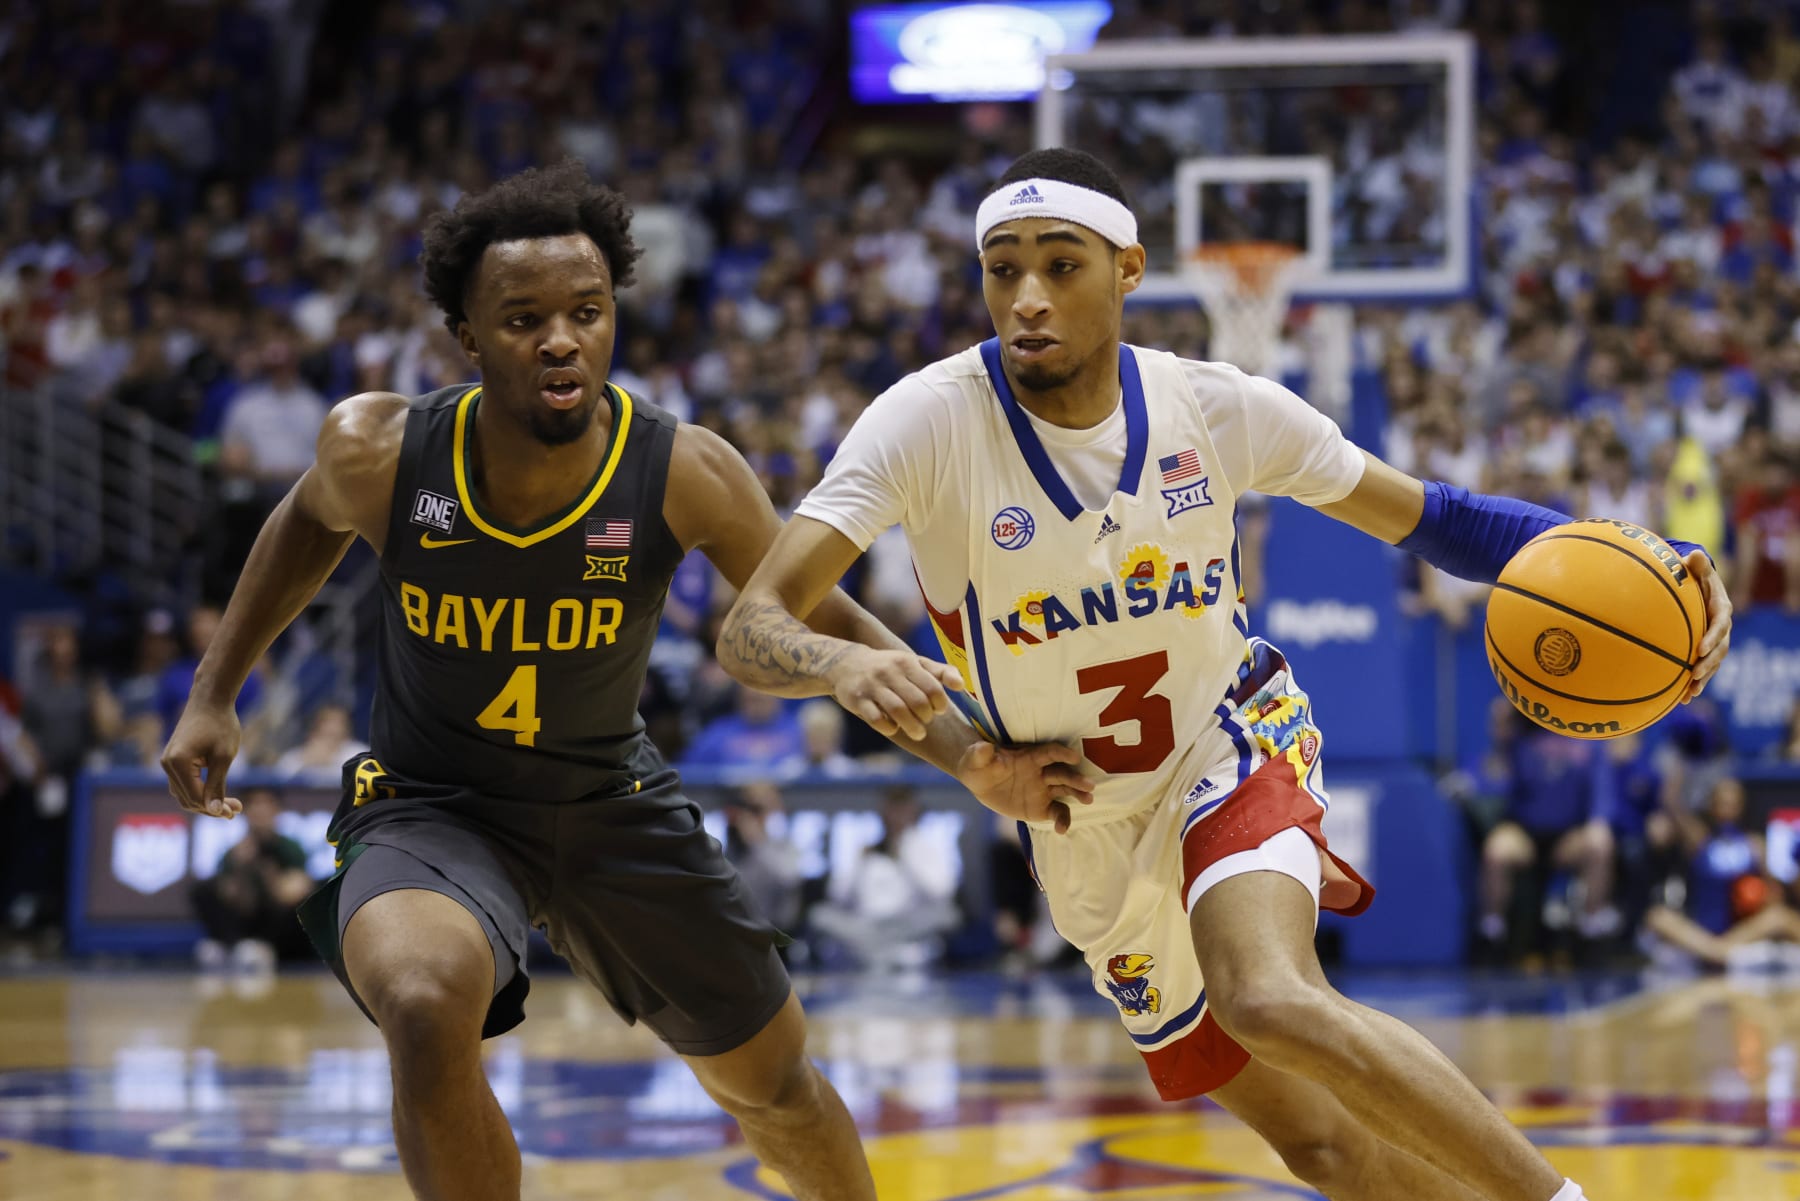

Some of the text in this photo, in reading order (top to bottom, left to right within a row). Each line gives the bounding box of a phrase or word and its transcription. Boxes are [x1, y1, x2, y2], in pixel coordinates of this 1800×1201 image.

[1010, 195, 1045, 206] adidas
[416, 494, 456, 525] ONE
[1160, 476, 1214, 520] XII
[995, 522, 1017, 538] 125
[1094, 523, 1121, 545] adidas
[583, 554, 630, 582] XII
[401, 581, 624, 652] BAYLOR
[991, 558, 1226, 657] KANSAS
[475, 664, 541, 747] 4
[1492, 657, 1622, 734] Wilson
[1076, 649, 1176, 775] 3
[1185, 785, 1219, 804] adidas
[1120, 988, 1139, 1002] KU
